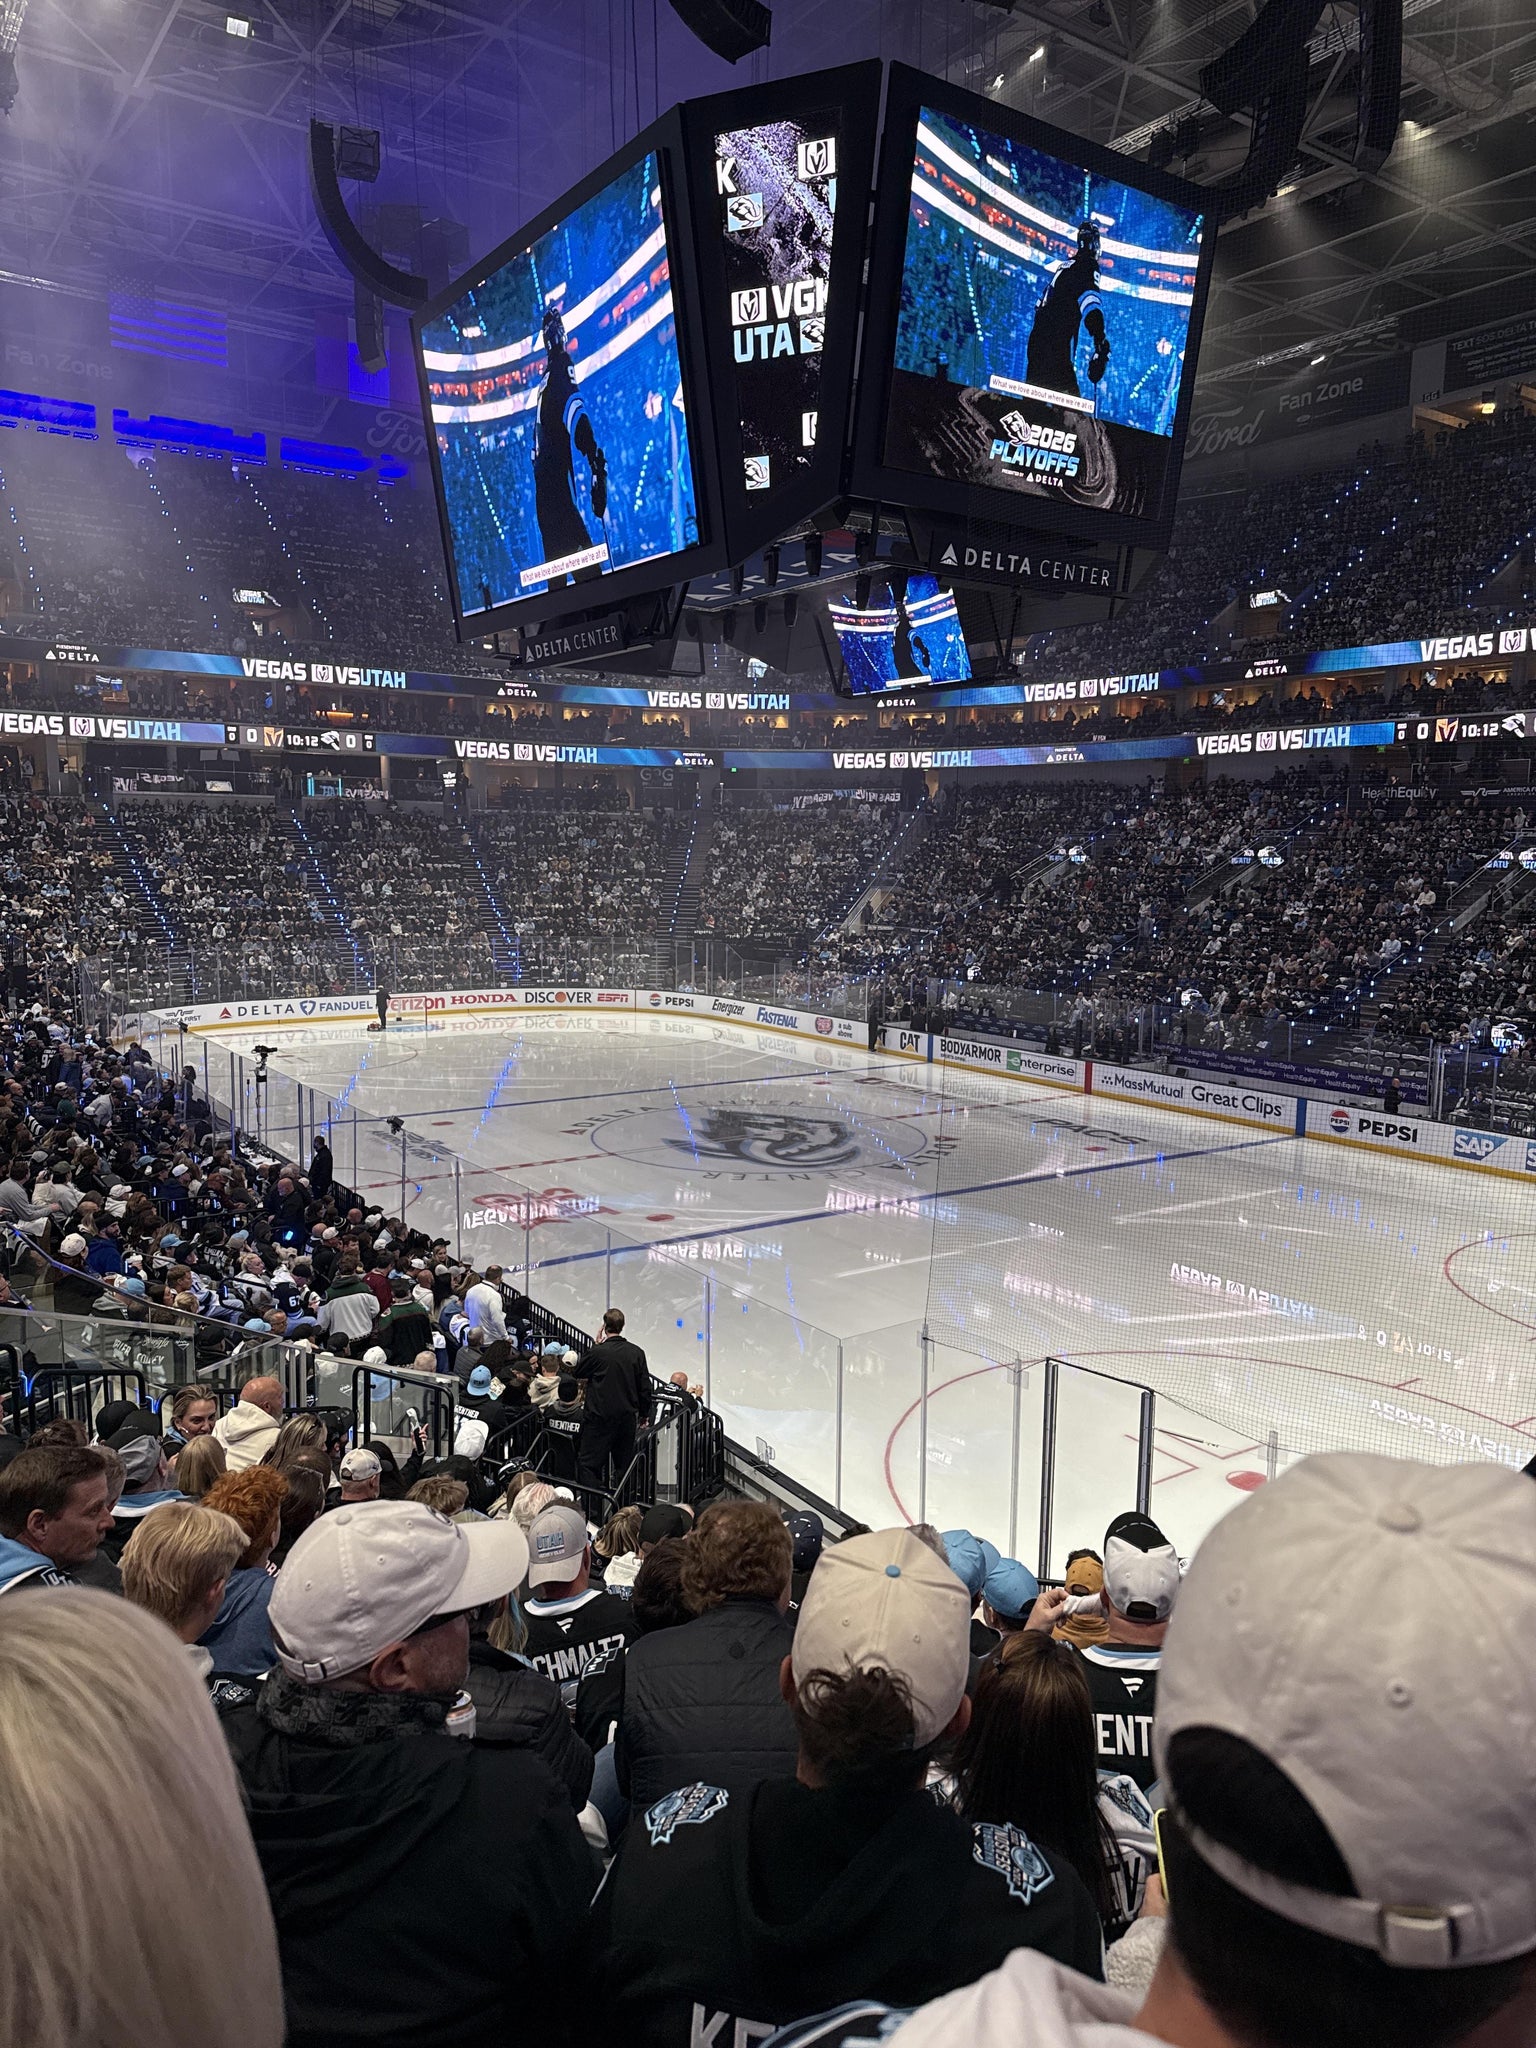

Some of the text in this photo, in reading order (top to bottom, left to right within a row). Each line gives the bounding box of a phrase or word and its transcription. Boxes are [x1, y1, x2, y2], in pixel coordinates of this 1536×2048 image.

[733, 322, 795, 363] UTA
[1452, 339, 1474, 352] TEXT
[1477, 332, 1496, 344] SOS
[5, 346, 114, 381] Fan Zone
[1017, 385, 1030, 395] love
[1031, 388, 1047, 399] about
[1279, 376, 1364, 413] Fan Zone
[367, 410, 428, 456] For
[1030, 424, 1077, 454] 2026
[1185, 406, 1265, 460] Ford
[989, 438, 1080, 478] PLAYOFFS
[1035, 474, 1064, 488] DELTA
[964, 548, 1111, 587] DELTA CENTER
[535, 625, 619, 659] DELTA CENTER
[1420, 633, 1493, 662] VEGAS
[58, 651, 100, 663] DELTA
[241, 658, 307, 681] VEGAS
[1255, 664, 1288, 677] DELTA
[507, 688, 537, 698] DELTA
[647, 691, 702, 708] VEGAS
[1024, 682, 1077, 702] VEGAS
[886, 698, 916, 707] DELTA
[246, 728, 257, 742] 0
[1416, 722, 1429, 740] 0
[1461, 723, 1499, 738] 10:12
[287, 734, 319, 747] 10:12
[346, 735, 356, 748] 0
[454, 740, 510, 759] VEGAS
[1197, 734, 1252, 755] VEGAS
[684, 757, 714, 766] DELTA
[833, 752, 886, 769] VEGAS
[1056, 752, 1085, 762] DELTA
[319, 1001, 372, 1013] FANDUEL
[450, 993, 518, 1005] HONDA
[525, 991, 592, 1004] DISCOVER
[597, 993, 629, 1003] ESPN
[665, 996, 694, 1008] PEPSI
[237, 1003, 295, 1018] DELTA
[712, 998, 745, 1017] Energizer
[756, 1006, 798, 1029] FASTENAL
[900, 1031, 921, 1053] CAT
[940, 1038, 1001, 1063] BODYARMOR
[1009, 1054, 1075, 1077] enterprise
[1114, 1075, 1184, 1099] MassMutual
[1399, 1080, 1427, 1091] ealthEquit
[1191, 1086, 1283, 1118] Great Clips
[573, 1105, 661, 1130] DELTA
[1331, 1116, 1350, 1126] PEPSI
[1358, 1117, 1418, 1143] PEPSI
[1455, 1134, 1495, 1157] SAP
[549, 1418, 580, 1433] GUENTHER
[536, 1531, 564, 1550] UTAH
[1091, 1713, 1153, 1757] ENT
[993, 1828, 1011, 1872] SEASON
